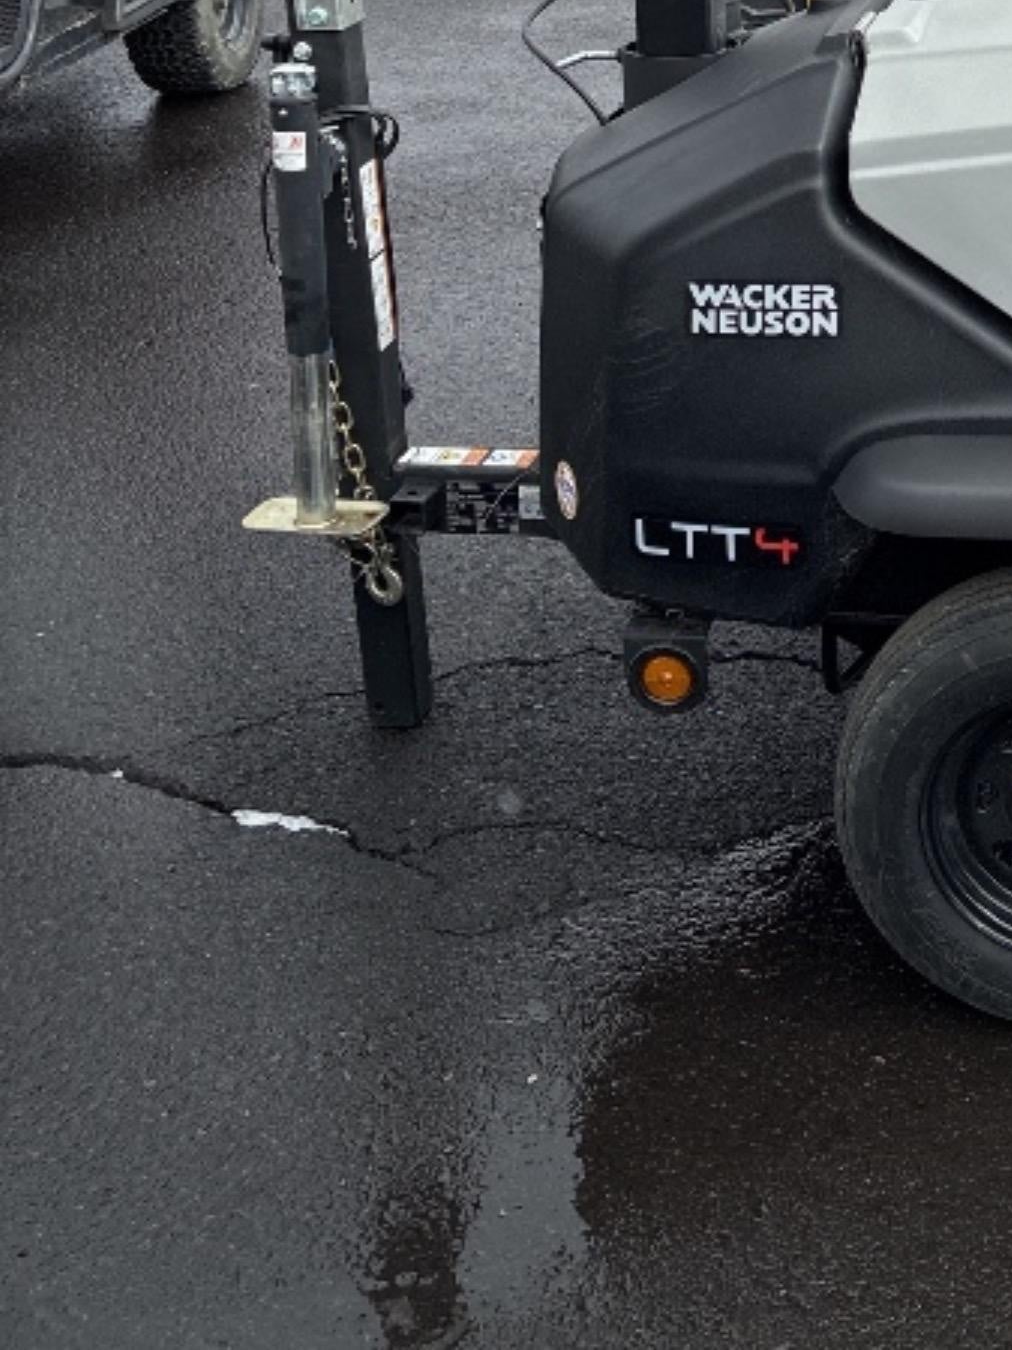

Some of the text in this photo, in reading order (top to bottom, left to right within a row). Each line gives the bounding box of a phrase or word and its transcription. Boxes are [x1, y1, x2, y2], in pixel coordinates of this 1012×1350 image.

[688, 282, 839, 310] WACKER
[691, 308, 839, 337] NEUSON
[634, 517, 799, 565] LTT4
